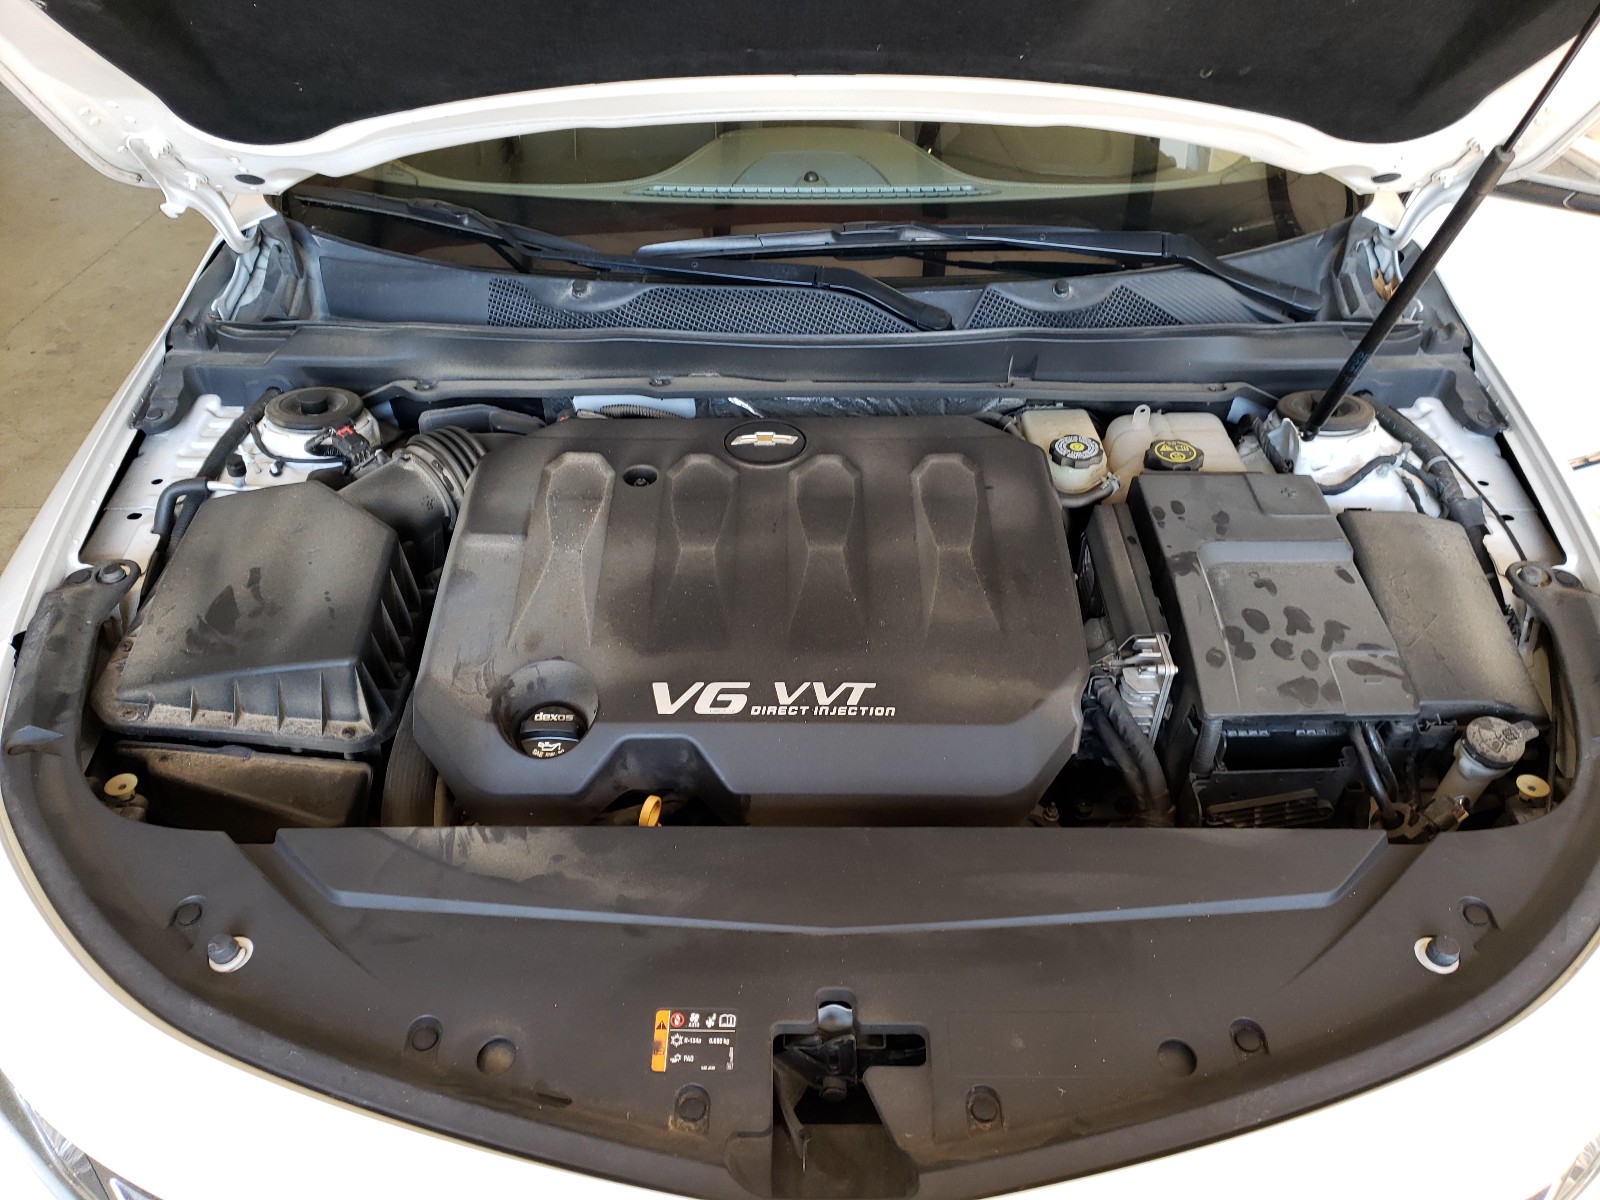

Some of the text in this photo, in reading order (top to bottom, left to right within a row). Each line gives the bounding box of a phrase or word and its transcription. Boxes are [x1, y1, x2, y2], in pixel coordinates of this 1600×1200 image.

[652, 681, 750, 715] V6
[774, 681, 876, 706] VVT
[534, 711, 575, 722] dexos
[750, 705, 896, 717] DIRECT INJECTION
